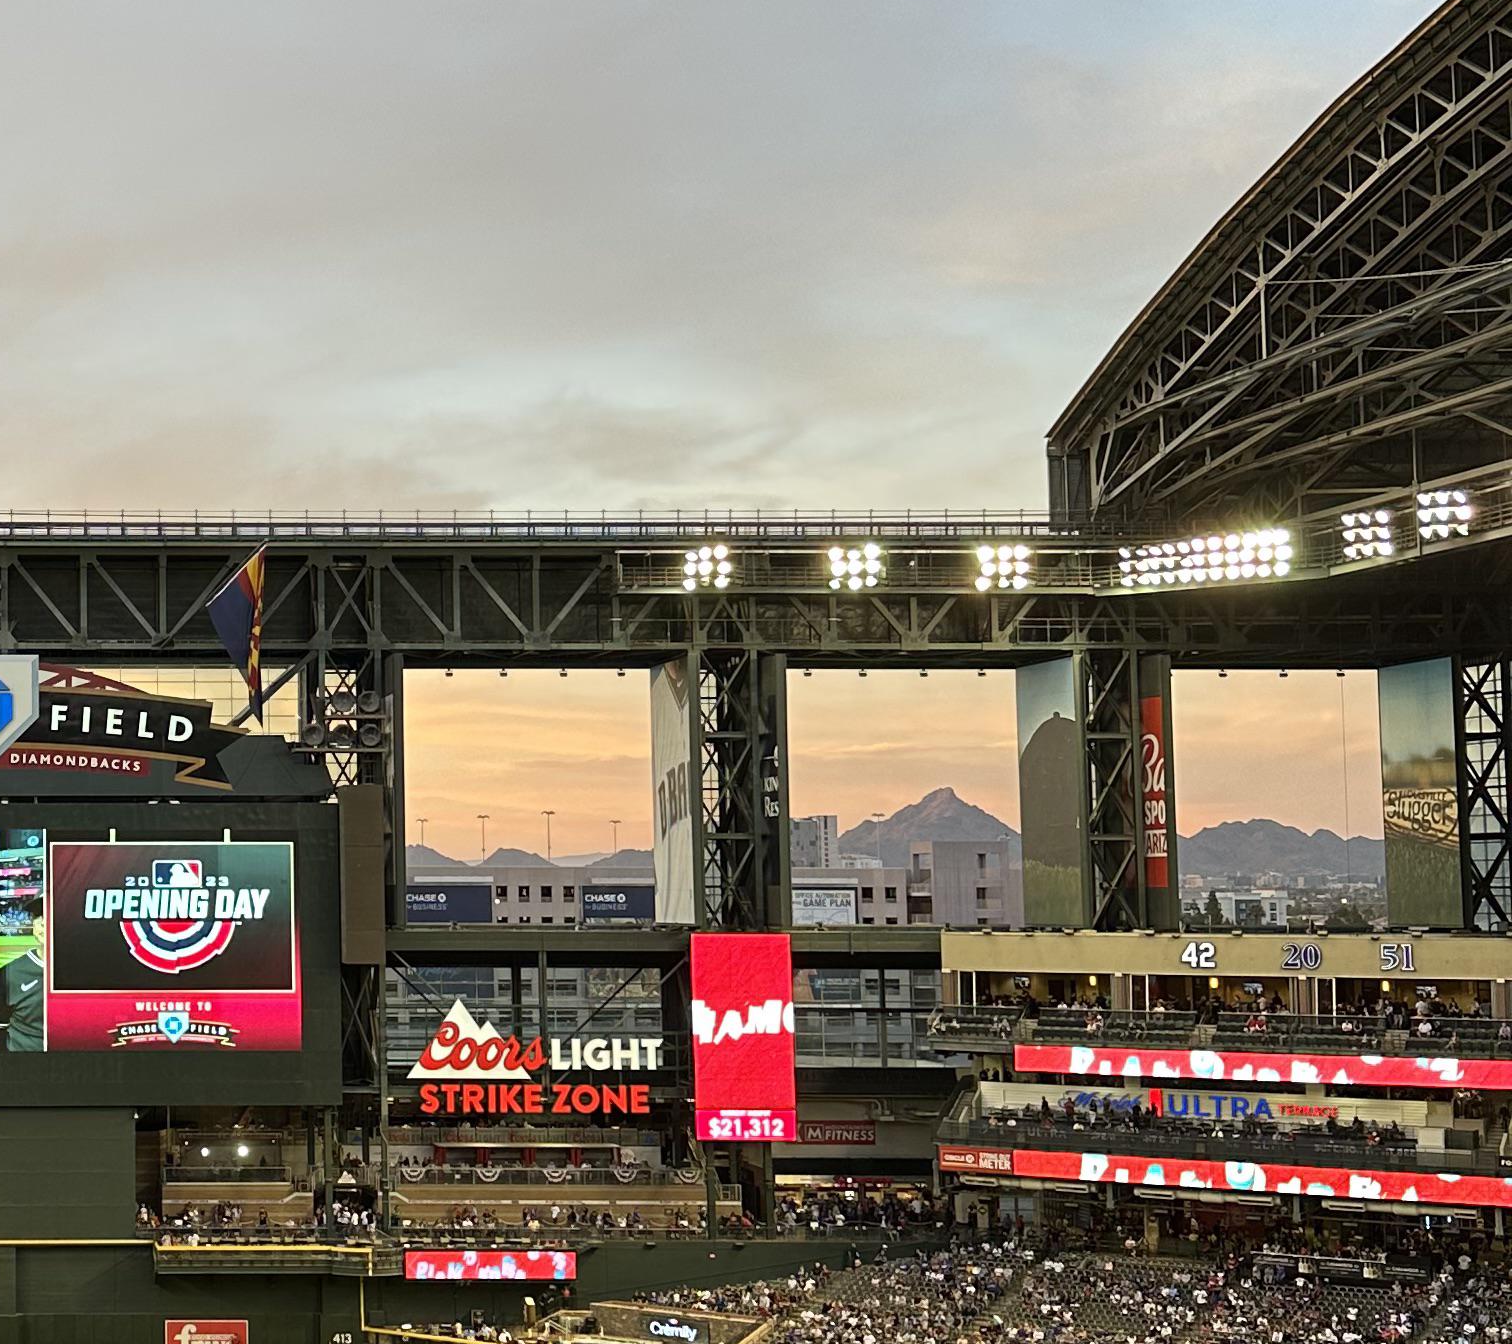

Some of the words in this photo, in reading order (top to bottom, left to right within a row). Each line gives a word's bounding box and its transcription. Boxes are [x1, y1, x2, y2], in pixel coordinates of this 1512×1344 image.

[50, 705, 194, 743] FIELD
[10, 752, 142, 771] DIAMONDBACKS
[1386, 791, 1451, 831] Slugger
[125, 876, 149, 887] 20
[206, 876, 229, 887] 23
[84, 889, 209, 919] OPENING
[214, 889, 270, 919] DAY
[406, 894, 437, 902] CHASE
[585, 894, 616, 902] CHASE
[803, 898, 826, 907] GAME
[830, 898, 851, 907] PLAN
[1181, 942, 1216, 968] 42
[1281, 943, 1321, 969] 20
[1380, 944, 1416, 971] 51
[135, 1001, 191, 1012] WELCOME
[197, 1001, 212, 1012] TO
[419, 1021, 547, 1071] Coors
[550, 1038, 664, 1071] LIGHT
[419, 1084, 543, 1114] STRIKE
[551, 1084, 650, 1114] ZONE
[1168, 1094, 1274, 1120] ULTRA
[708, 1117, 784, 1138] $21,312
[825, 1129, 875, 1141] FITNESS
[979, 1159, 1011, 1170] METER
[333, 1332, 352, 1344] 413
